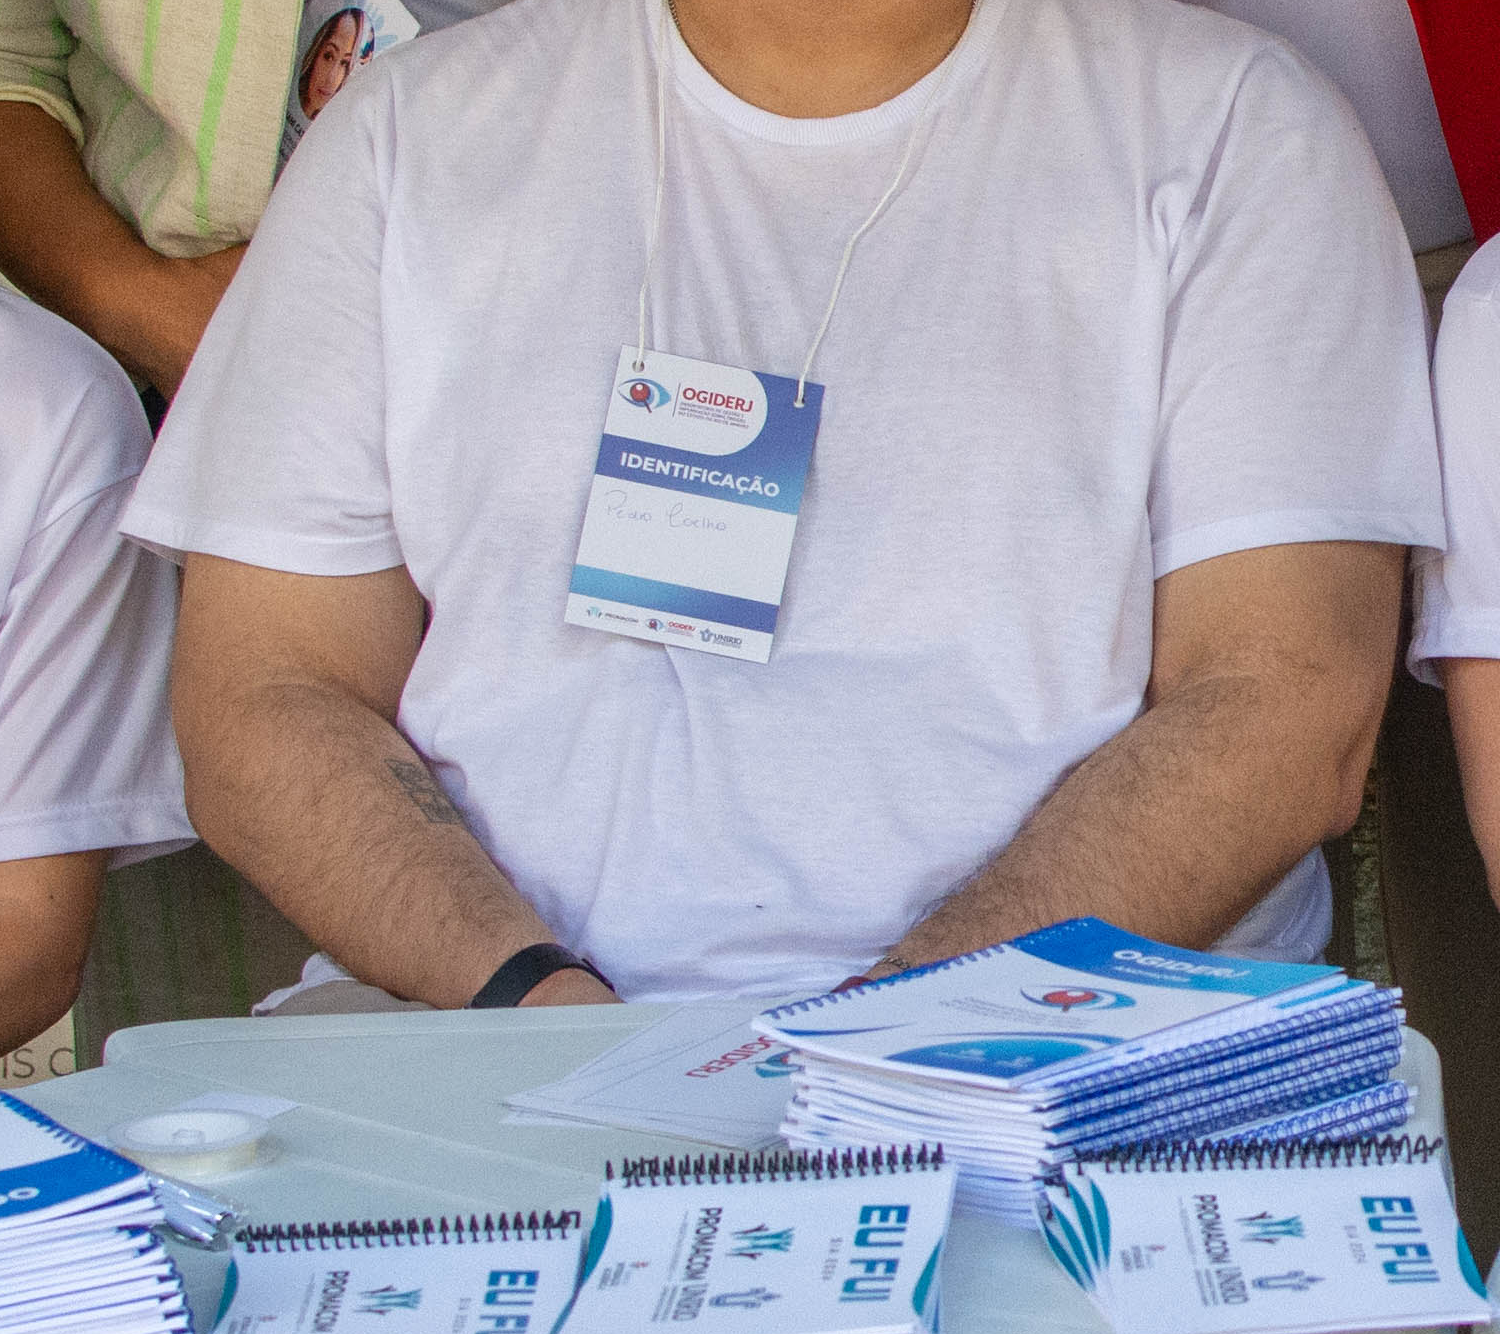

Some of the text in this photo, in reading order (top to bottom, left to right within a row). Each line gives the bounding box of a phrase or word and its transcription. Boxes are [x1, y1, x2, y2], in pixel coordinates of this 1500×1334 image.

[683, 387, 754, 412] OGIDERJ
[620, 451, 780, 498] IDENTIFICAÇÃO
[1113, 950, 1252, 978] OGIDERJ
[684, 1206, 723, 1282] PROMACOM
[838, 1204, 910, 1304] EU FUI
[1192, 1194, 1233, 1264] PROMACOM
[1360, 1195, 1441, 1284] EU FUI
[310, 1270, 351, 1334] PROMACOM
[483, 1269, 540, 1306] EU
